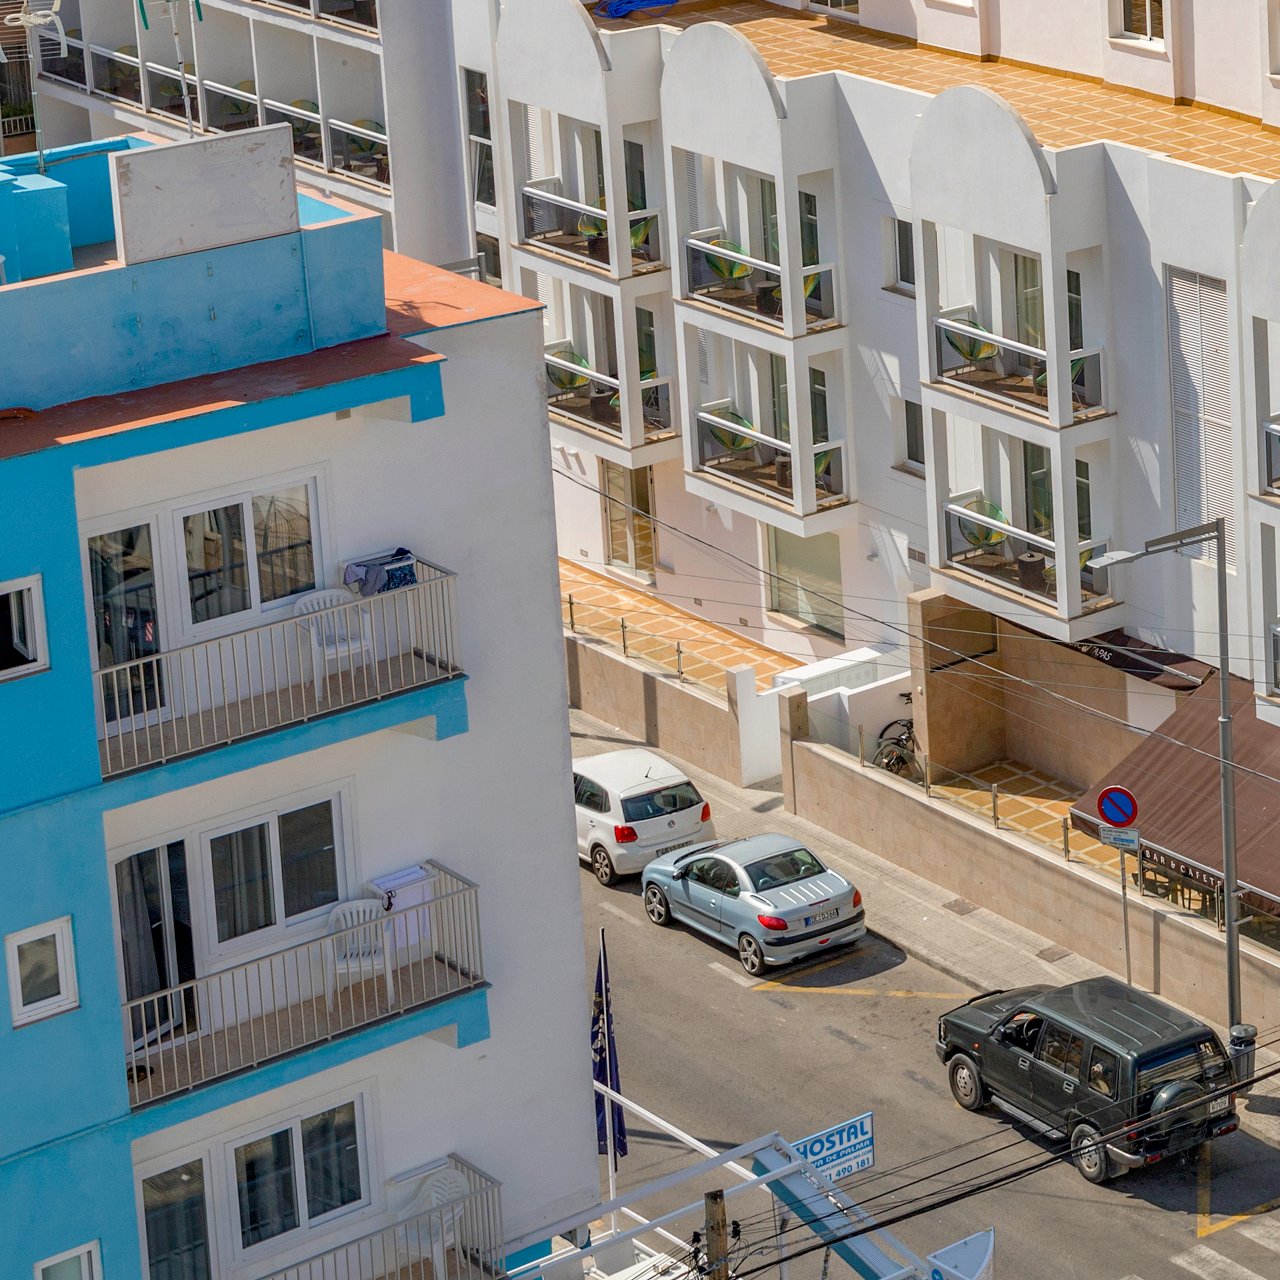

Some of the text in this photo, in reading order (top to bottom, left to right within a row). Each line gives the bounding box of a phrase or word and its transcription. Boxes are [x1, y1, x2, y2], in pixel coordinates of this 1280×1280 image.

[1144, 849, 1166, 865] BAR
[795, 1120, 869, 1159] HOSTAL
[826, 1140, 870, 1163] DE PALMA
[835, 1165, 853, 1178] 490
[856, 1157, 870, 1170] 181
